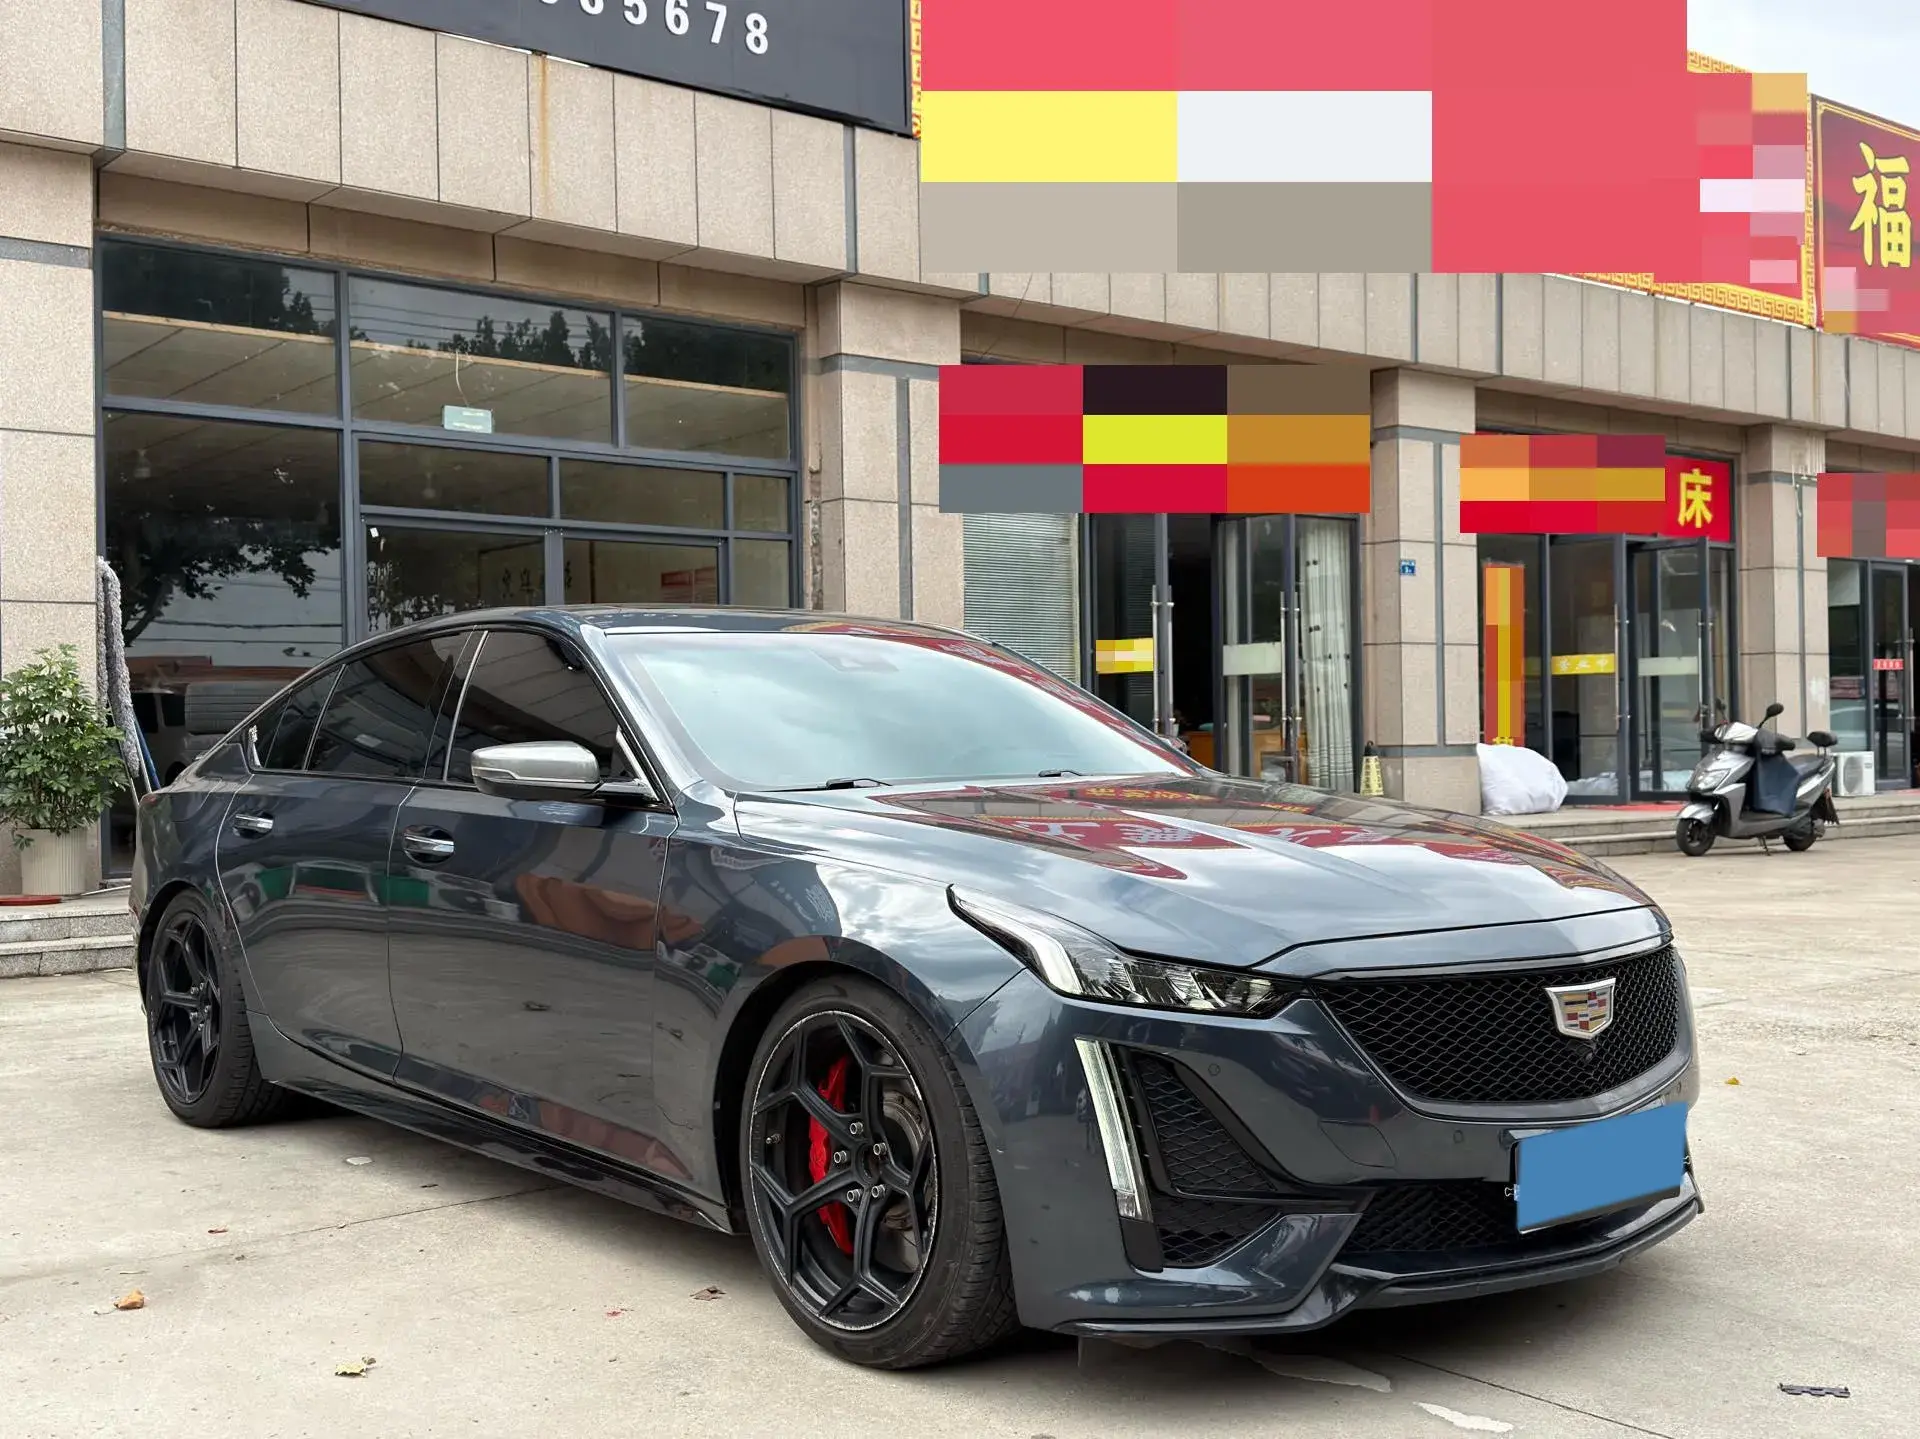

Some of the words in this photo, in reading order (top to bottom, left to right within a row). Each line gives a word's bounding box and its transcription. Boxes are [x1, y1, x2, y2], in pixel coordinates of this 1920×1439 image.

[540, 0, 769, 55] 5678
[1848, 141, 1912, 268] 福
[1677, 468, 1714, 529] 床
